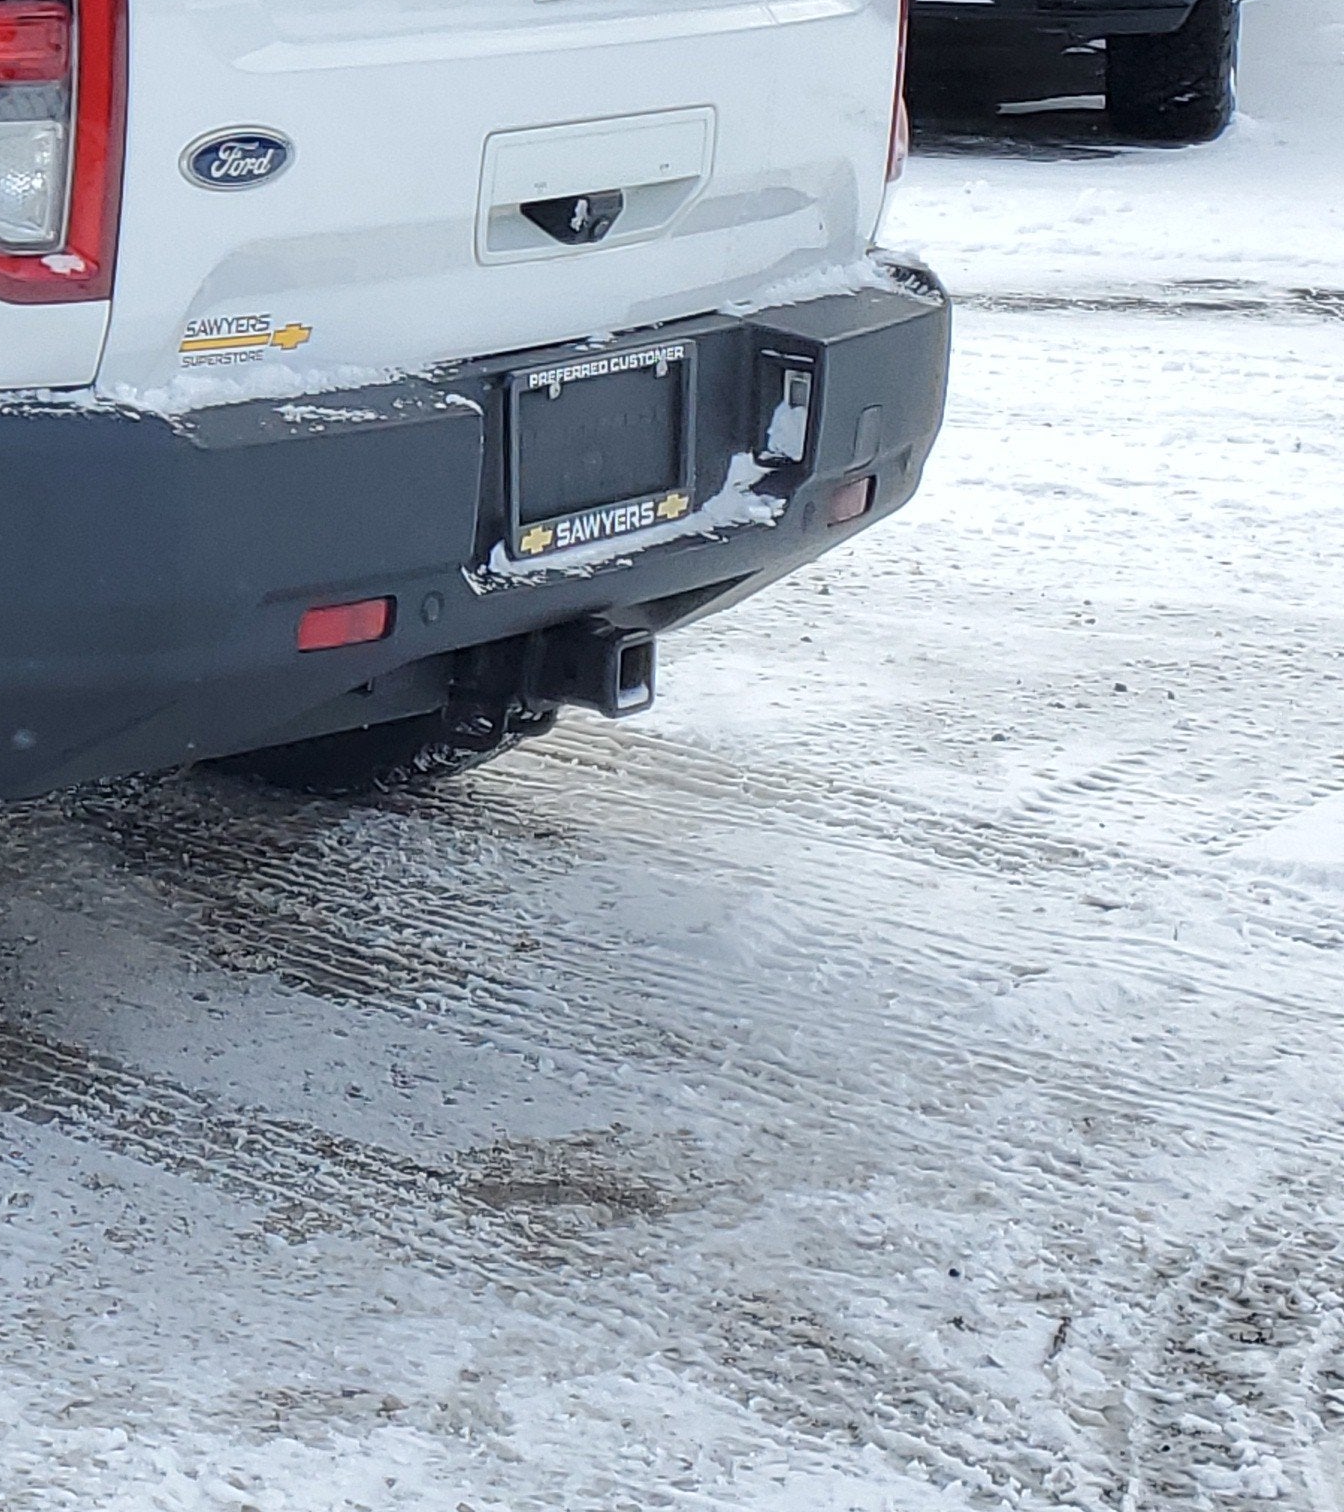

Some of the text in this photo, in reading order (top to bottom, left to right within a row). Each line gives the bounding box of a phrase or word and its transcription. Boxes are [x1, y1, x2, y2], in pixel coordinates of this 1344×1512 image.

[211, 141, 275, 178] Ford
[184, 314, 271, 338] SAWYERS
[181, 350, 264, 368] SUPERSTORE
[529, 346, 685, 389] PREFERRED CUSTOMER
[556, 501, 655, 548] SAWYERS
